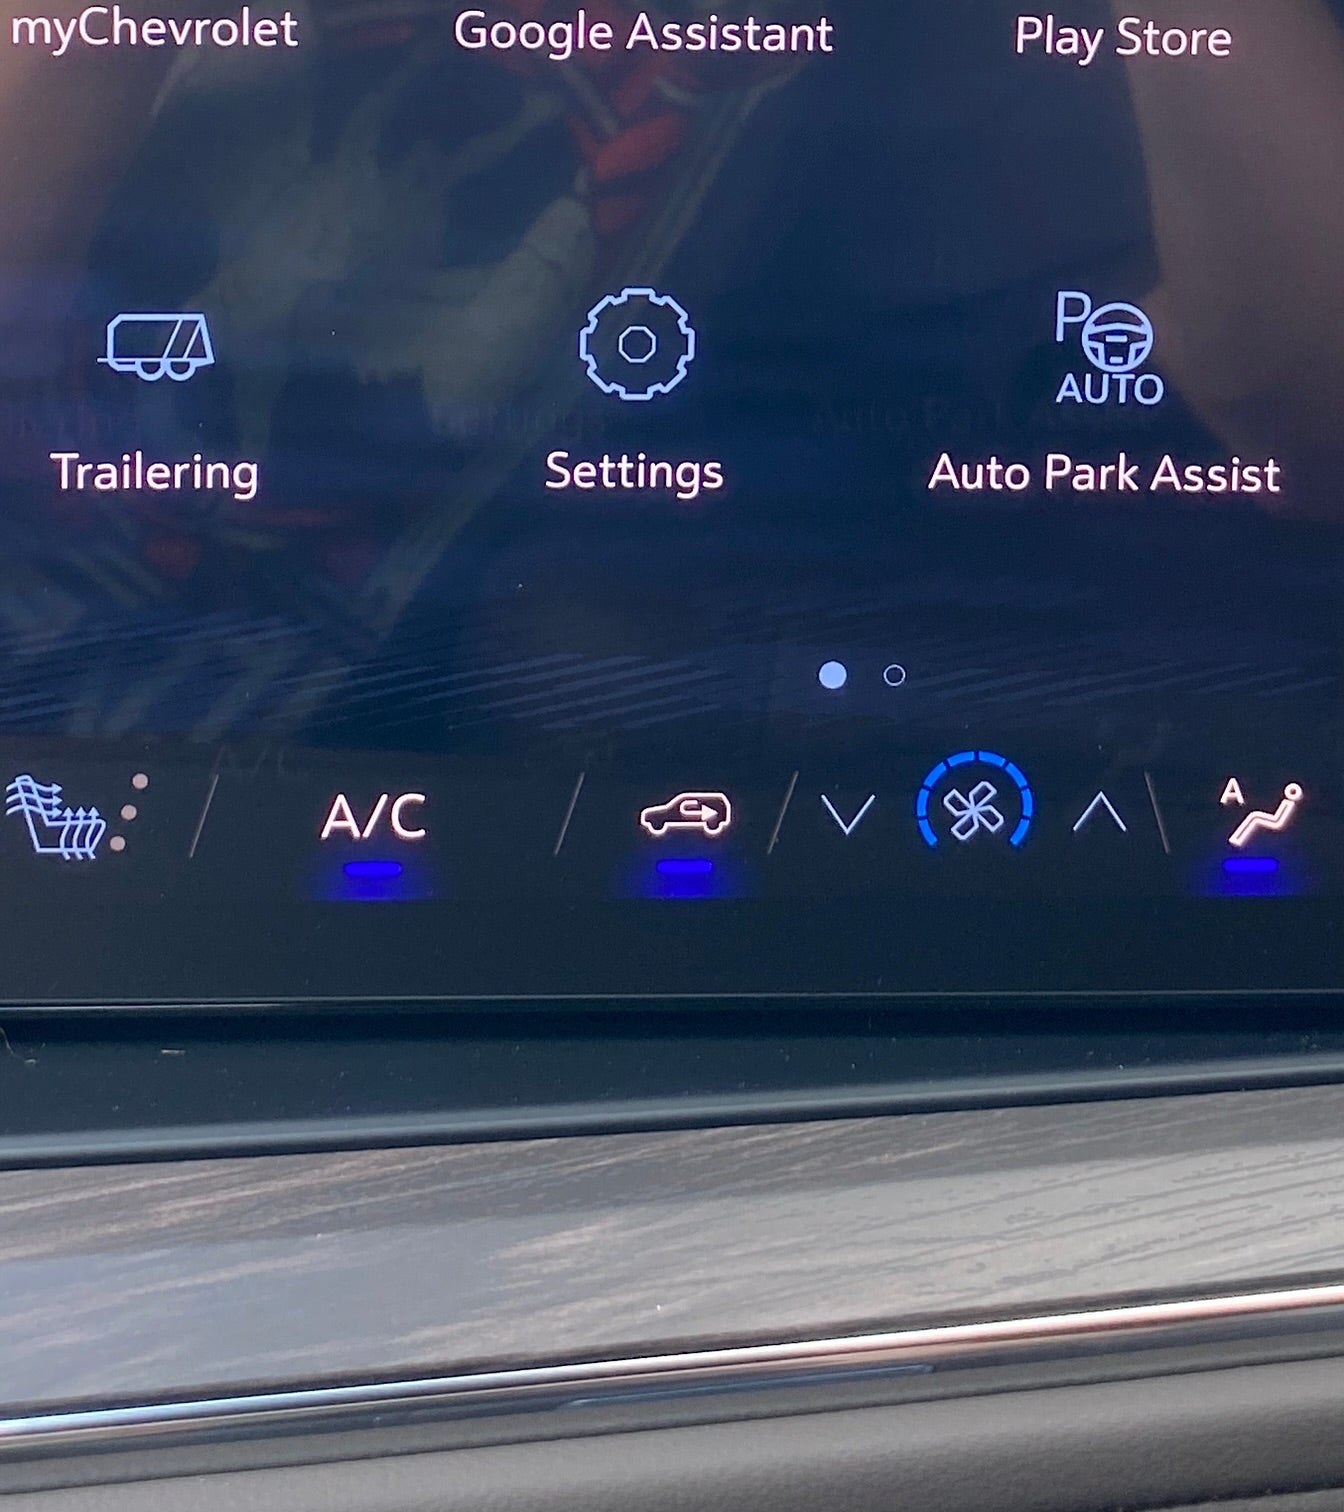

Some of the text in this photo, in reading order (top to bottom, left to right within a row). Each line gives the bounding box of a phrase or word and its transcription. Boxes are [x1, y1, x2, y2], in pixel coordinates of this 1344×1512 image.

[12, 4, 299, 57] myChevrolet
[455, 9, 833, 61] Google Assistant
[1016, 14, 1232, 66] Play Store
[1056, 290, 1091, 343] P
[1055, 372, 1164, 405] AUTO
[49, 450, 258, 500] Trailering
[545, 451, 724, 500] Settings
[927, 452, 1281, 493] Auto Park Assist
[1219, 777, 1245, 805] A
[321, 793, 426, 840] A/C
